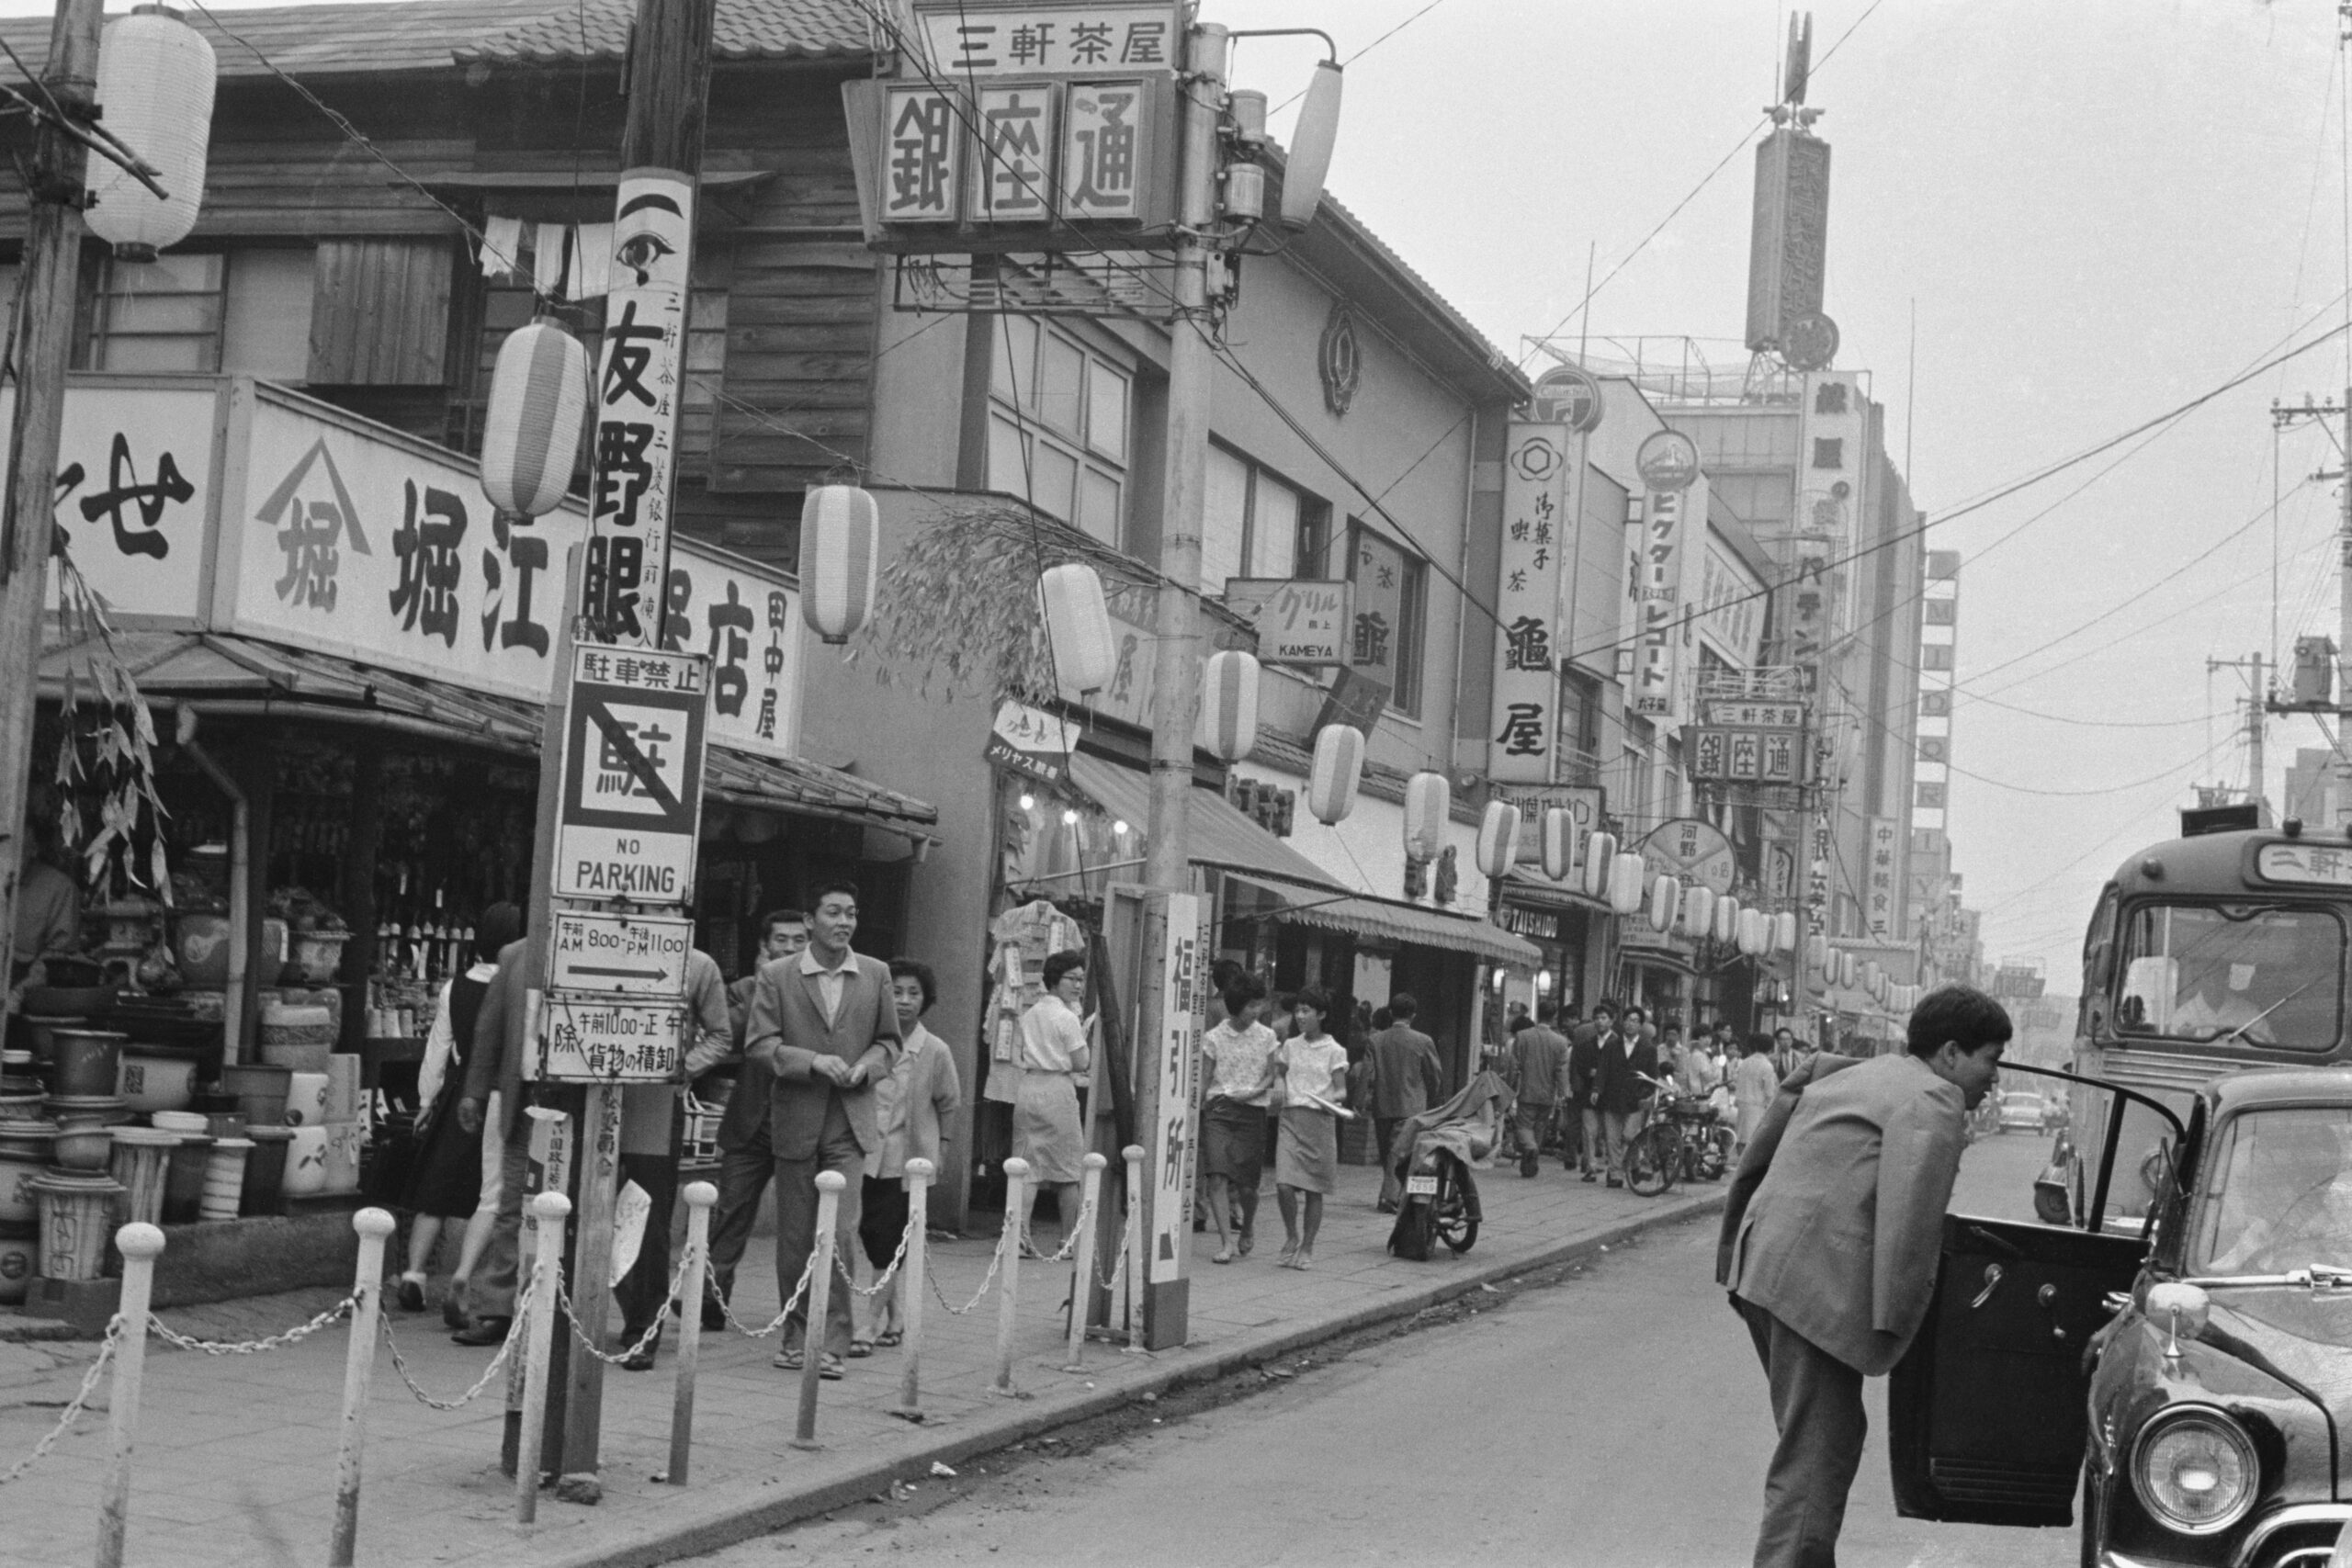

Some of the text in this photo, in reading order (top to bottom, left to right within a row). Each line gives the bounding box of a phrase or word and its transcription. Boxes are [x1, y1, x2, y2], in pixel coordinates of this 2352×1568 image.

[952, 21, 1166, 69] 三軒茶屋
[893, 92, 1134, 211] 銀座通
[1279, 644, 1333, 658] KAMEYA
[582, 650, 700, 693] 駐車禁止
[756, 591, 787, 740] 田中屋
[1722, 707, 1798, 724] 三軒茶屋
[1700, 735, 1790, 776] 銀座通
[616, 838, 640, 855] NO
[576, 861, 675, 894] PARKING
[562, 921, 583, 936] 午前
[629, 926, 650, 941] 午後
[560, 938, 583, 952] AM
[627, 942, 648, 955] PM
[588, 1043, 675, 1073] 貨物の積卸
